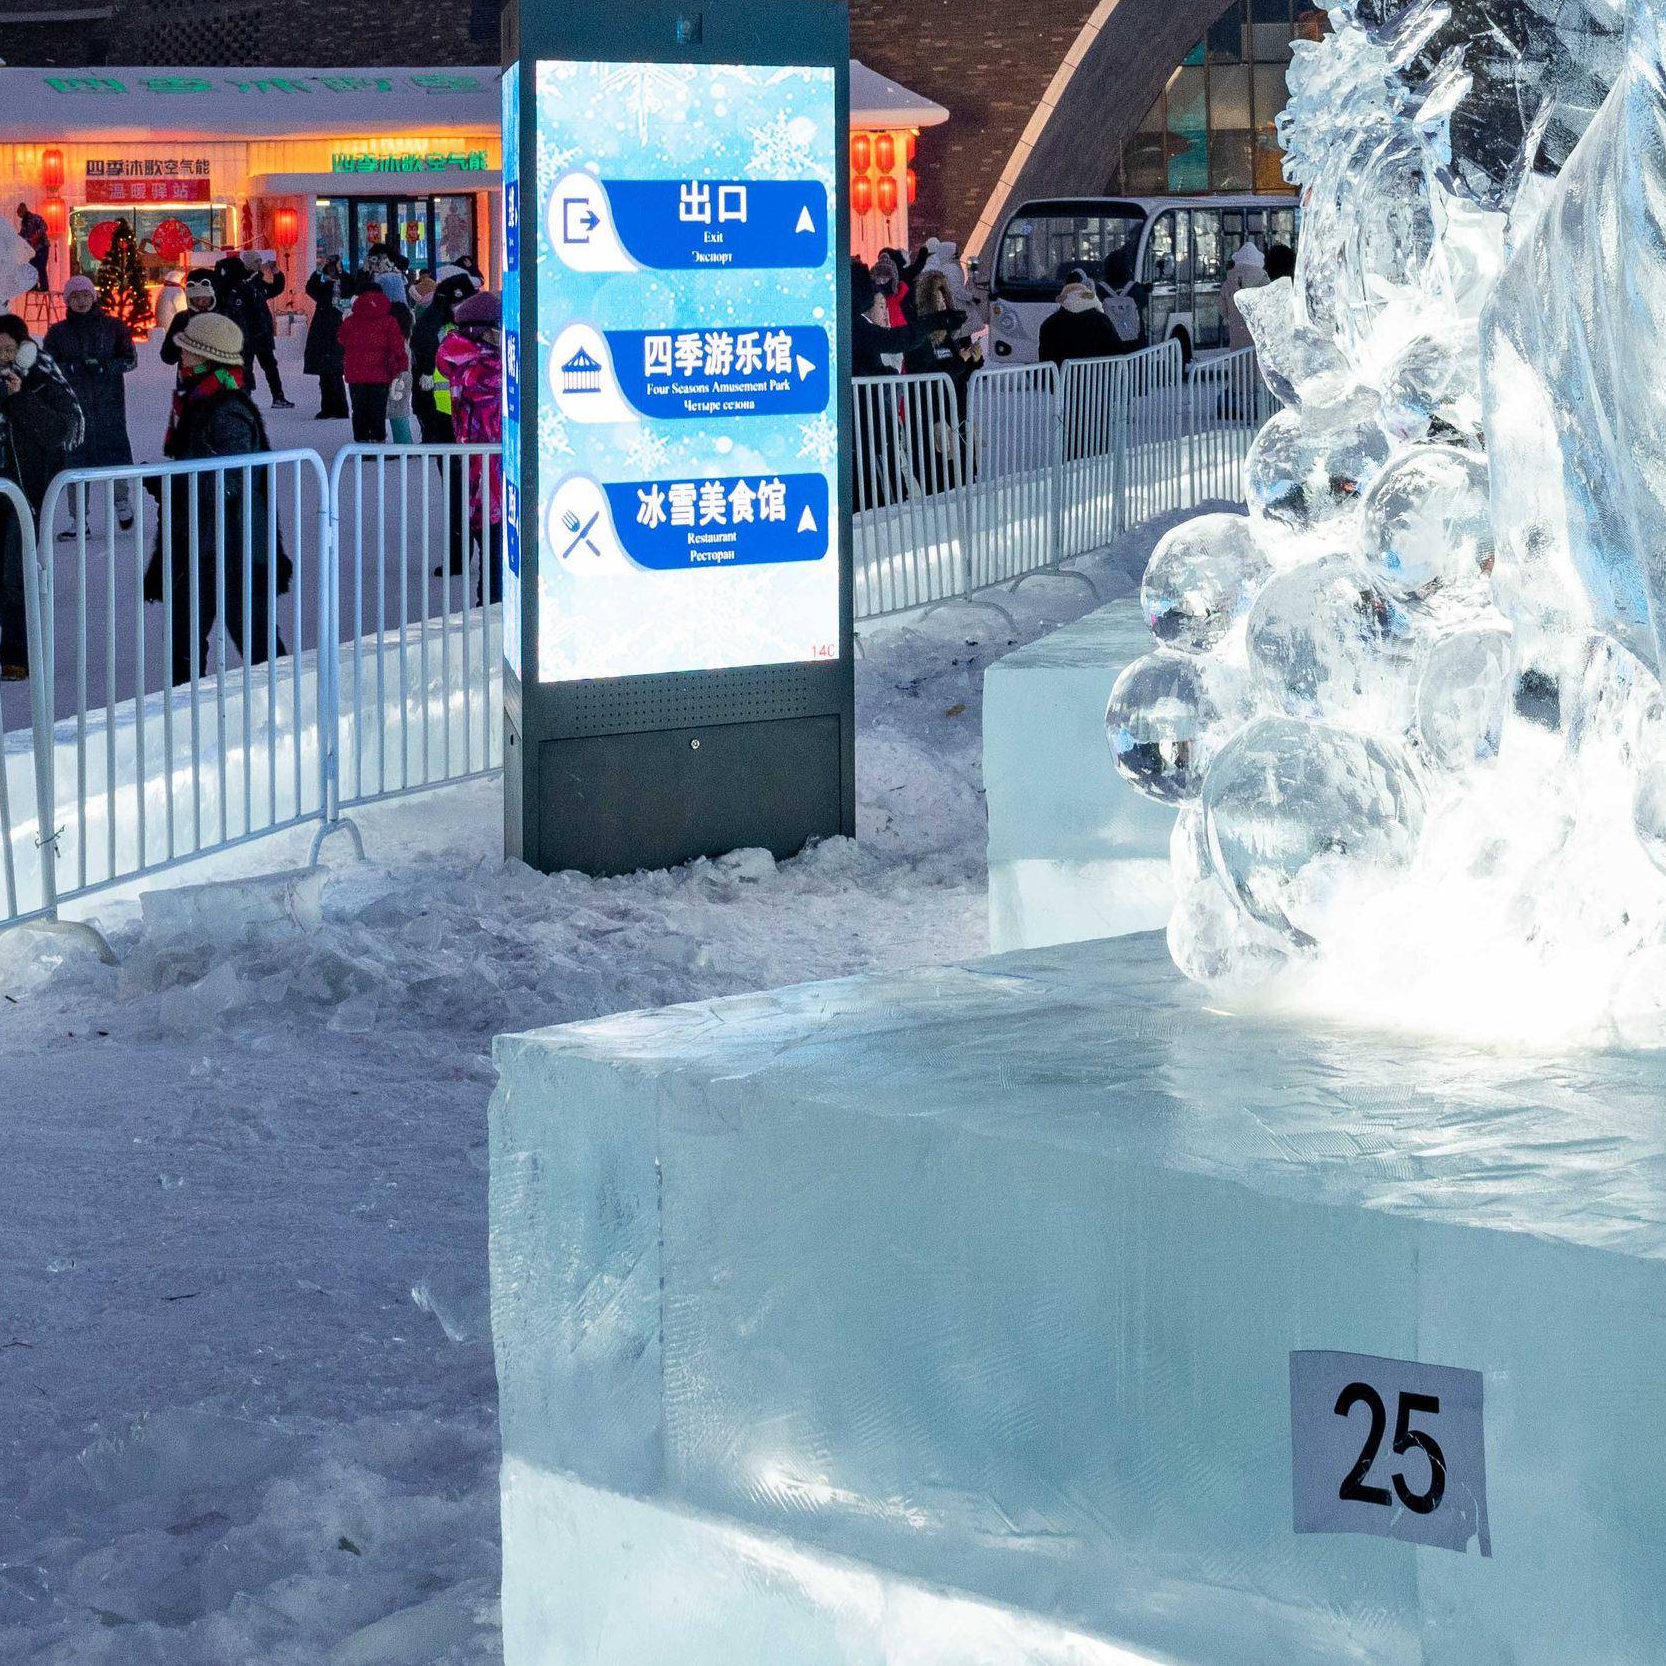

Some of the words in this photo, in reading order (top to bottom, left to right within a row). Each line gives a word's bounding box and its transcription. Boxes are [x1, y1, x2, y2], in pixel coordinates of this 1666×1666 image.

[86, 159, 210, 176] 四季沐歌空气能
[110, 182, 189, 200] 温暖驿站
[679, 180, 747, 224] 出口
[703, 230, 724, 243] Exit
[691, 250, 733, 265] Экспорт
[644, 330, 793, 377] 四季游乐馆
[646, 383, 670, 395] Four
[671, 382, 710, 394] Seasons
[712, 381, 768, 393] Amusement
[769, 379, 791, 391] Park
[684, 399, 721, 413] Четыре
[636, 477, 787, 529] 冰雪美食馆
[687, 532, 737, 545] Restaurant
[690, 550, 735, 563] Ресторан
[1333, 1382, 1447, 1515] 25
